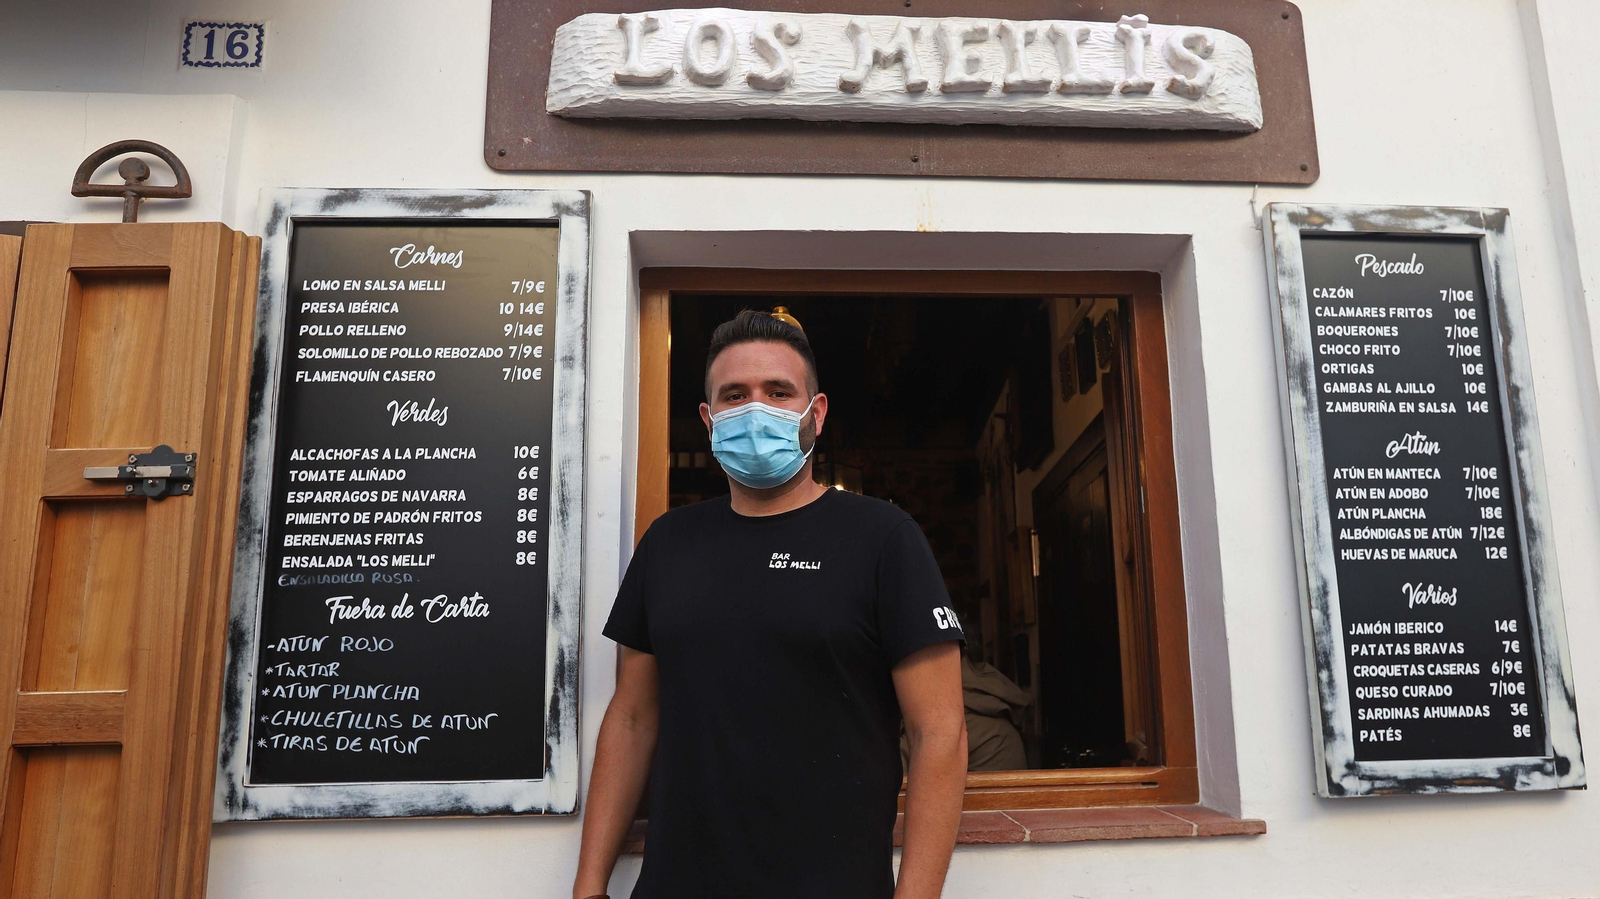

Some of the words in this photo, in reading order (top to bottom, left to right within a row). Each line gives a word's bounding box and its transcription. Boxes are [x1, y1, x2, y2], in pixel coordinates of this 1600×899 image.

[204, 30, 249, 60] 16
[613, 13, 802, 91] LOS
[390, 244, 463, 268] Carnes
[1355, 253, 1424, 277] Pescado
[303, 280, 340, 290] LOMO
[344, 280, 361, 290] EN
[364, 280, 405, 290] SALSA
[409, 280, 445, 290] MELLI
[512, 279, 545, 295] 7/9€
[1313, 286, 1353, 298] CAZÓN
[1440, 288, 1473, 303] 7/10€
[301, 302, 344, 313] PRESA
[348, 300, 398, 313] IBÉRICA
[500, 303, 514, 314] 10
[520, 303, 544, 314] 14€
[1315, 307, 1386, 317] CALAMARES
[1389, 308, 1432, 318] FRITOS
[1455, 308, 1476, 319] 10€
[300, 325, 343, 336] POLLO
[347, 325, 406, 335] RELLENO
[504, 322, 543, 338] 9/14€
[1317, 325, 1398, 336] BOQUERONES
[1445, 325, 1478, 339] 7/10€
[298, 348, 368, 358] SOLOMILLO
[371, 348, 387, 358] DE
[390, 348, 432, 358] POLLO
[435, 347, 503, 358] REBOZADO
[509, 344, 542, 360] 7/9€
[1320, 344, 1360, 354] CHOCO
[1364, 345, 1400, 355] FRITO
[1447, 343, 1481, 358] 7/10€
[296, 369, 379, 382] FLAMENQUÍN
[383, 371, 435, 381] CASERO
[503, 366, 542, 382] 7/10€
[1322, 363, 1374, 374] ORTIGAS
[1462, 364, 1483, 375] 10€
[1324, 382, 1372, 393] GAMBAS
[1377, 383, 1391, 393] AL
[1396, 383, 1435, 393] AJILLO
[1464, 382, 1486, 394] 10€
[387, 398, 448, 426] Verdes
[1326, 400, 1396, 412] ZAMBURIÑA
[1399, 402, 1414, 412] EN
[1419, 402, 1456, 413] SALSA
[1467, 401, 1488, 413] 14€
[290, 448, 379, 460] ALCACHOFAS
[382, 448, 391, 459] A
[395, 448, 411, 459] LA
[415, 448, 476, 459] PLANCHA
[514, 446, 539, 458] 10€
[290, 470, 345, 481] TOMATE
[349, 468, 406, 481] ALIÑADO
[518, 467, 538, 479] 6€
[1334, 466, 1364, 479] ATÚN
[1368, 468, 1383, 479] EN
[1386, 468, 1441, 479] MANTECA
[1463, 465, 1497, 481] 7/10€
[287, 491, 378, 503] ESPARRAGOS
[382, 491, 398, 502] DE
[402, 490, 466, 501] NAVARRA
[518, 488, 538, 500] 8€
[1336, 486, 1367, 499] ATÚN
[1370, 488, 1385, 499] EN
[1389, 488, 1428, 499] ADOBO
[1465, 485, 1499, 501] 7/10€
[286, 513, 350, 524] PIMIENTO
[353, 512, 370, 523] DE
[374, 509, 429, 523] PADRÓN
[433, 511, 482, 522] FRITOS
[517, 509, 537, 522] 8€
[1338, 506, 1369, 519] ATÚN
[1372, 508, 1426, 519] PLANCHA
[1481, 507, 1502, 519] 18€
[284, 534, 371, 546] BERENJENAS
[375, 533, 423, 545] FRITAS
[517, 530, 537, 543] 8€
[1340, 526, 1411, 539] ALBÓNDIGAS
[1414, 528, 1428, 539] DE
[1432, 526, 1462, 539] ATÚN
[1470, 525, 1505, 541] 7/12€
[282, 555, 353, 568] ENSALADA
[516, 552, 536, 565] 8€
[771, 552, 790, 560] BAR
[1342, 549, 1388, 560] HUEVAS
[1391, 549, 1406, 559] DE
[1409, 548, 1457, 559] MARUCA
[1485, 547, 1507, 559] 12€
[769, 560, 788, 569] LOS
[790, 561, 821, 570] MELLI
[1402, 583, 1457, 609] Varios
[326, 596, 385, 624] Fuera
[391, 593, 414, 618] de
[421, 592, 489, 623] Carta
[1350, 621, 1391, 635] JAMÓN
[1395, 622, 1443, 634] IBERICO
[1495, 620, 1517, 632] 14€
[1352, 643, 1410, 656] PATATAS
[1414, 642, 1464, 655] BRAVAS
[1502, 640, 1519, 653] 7€
[1354, 664, 1424, 677] CROQUETAS
[1427, 663, 1480, 675] CASERAS
[1492, 659, 1522, 676] 6/9€
[1356, 686, 1398, 699] QUESO
[1402, 685, 1452, 697] CURADO
[1490, 680, 1525, 697] 7/10€
[1358, 707, 1419, 720] SARDINAS
[1424, 705, 1490, 718] AHUMADAS
[1511, 703, 1528, 716] 3€
[1360, 727, 1402, 742] PATÉS
[1513, 724, 1530, 737] 8€
